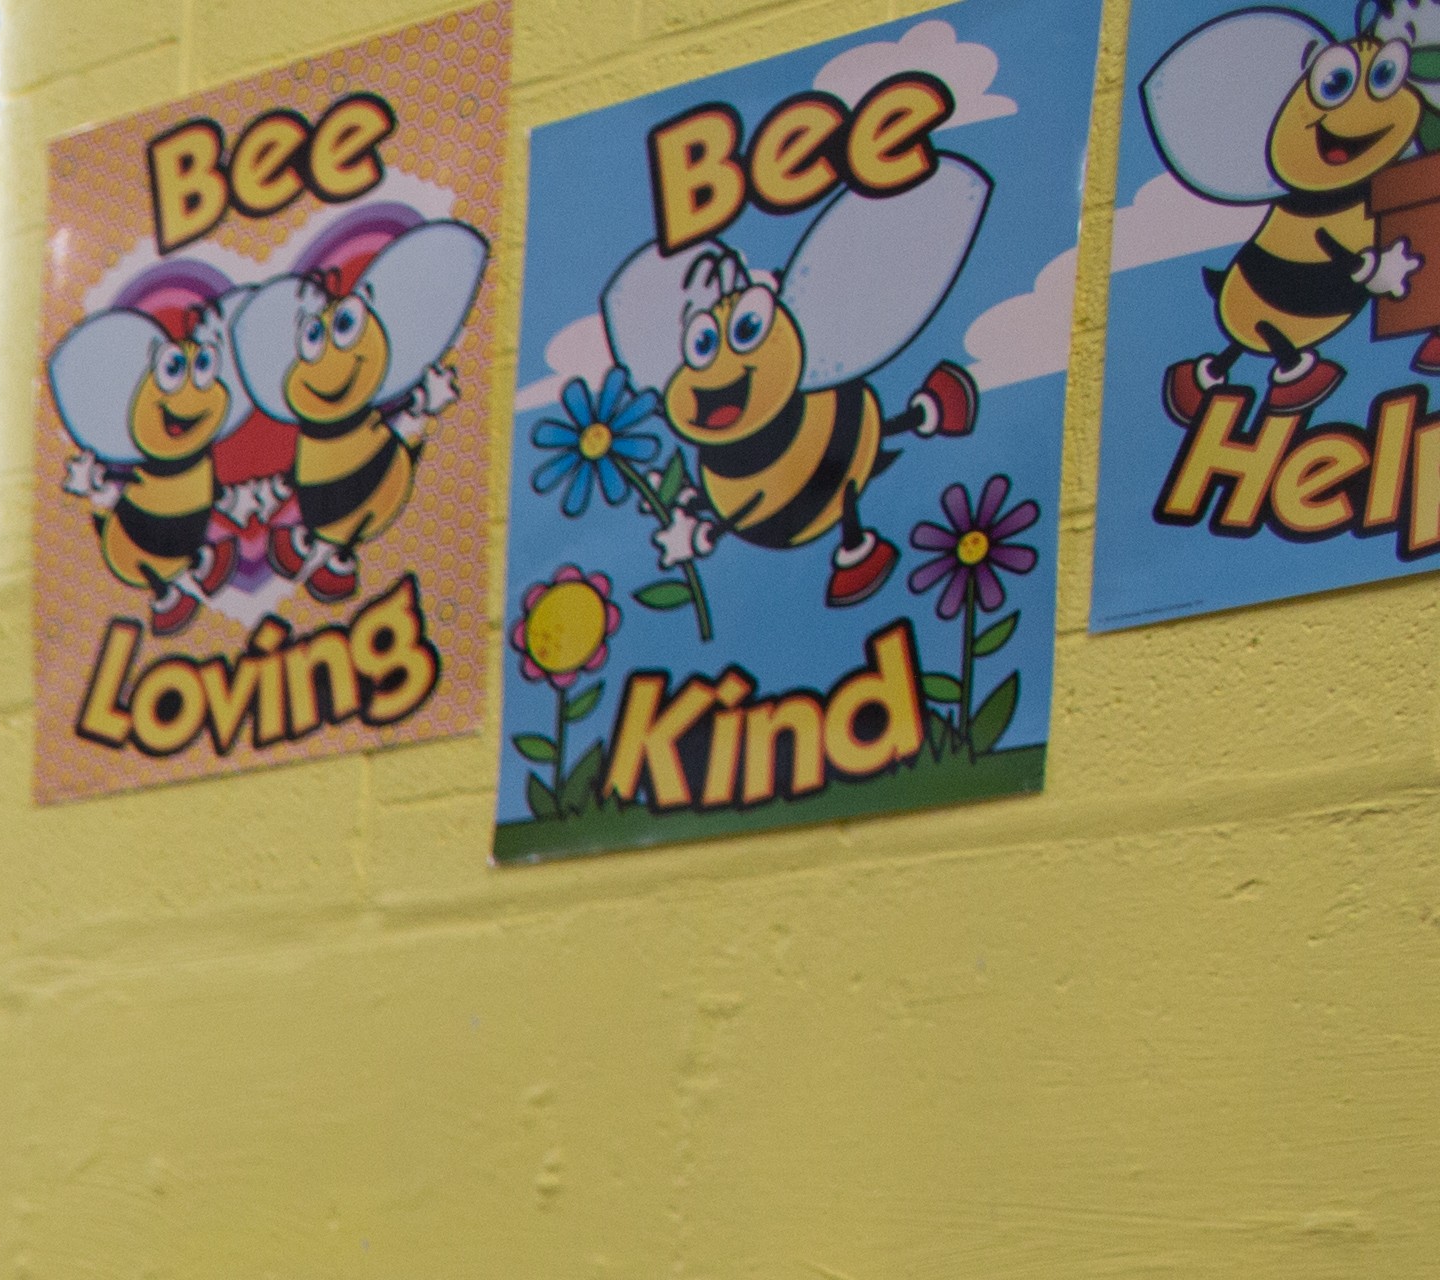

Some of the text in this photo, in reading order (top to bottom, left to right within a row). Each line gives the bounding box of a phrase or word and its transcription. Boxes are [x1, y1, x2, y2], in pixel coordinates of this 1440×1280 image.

[147, 90, 399, 254] Bee
[647, 70, 955, 258] Bee
[76, 574, 440, 756] Loving
[602, 620, 928, 815] Kind
